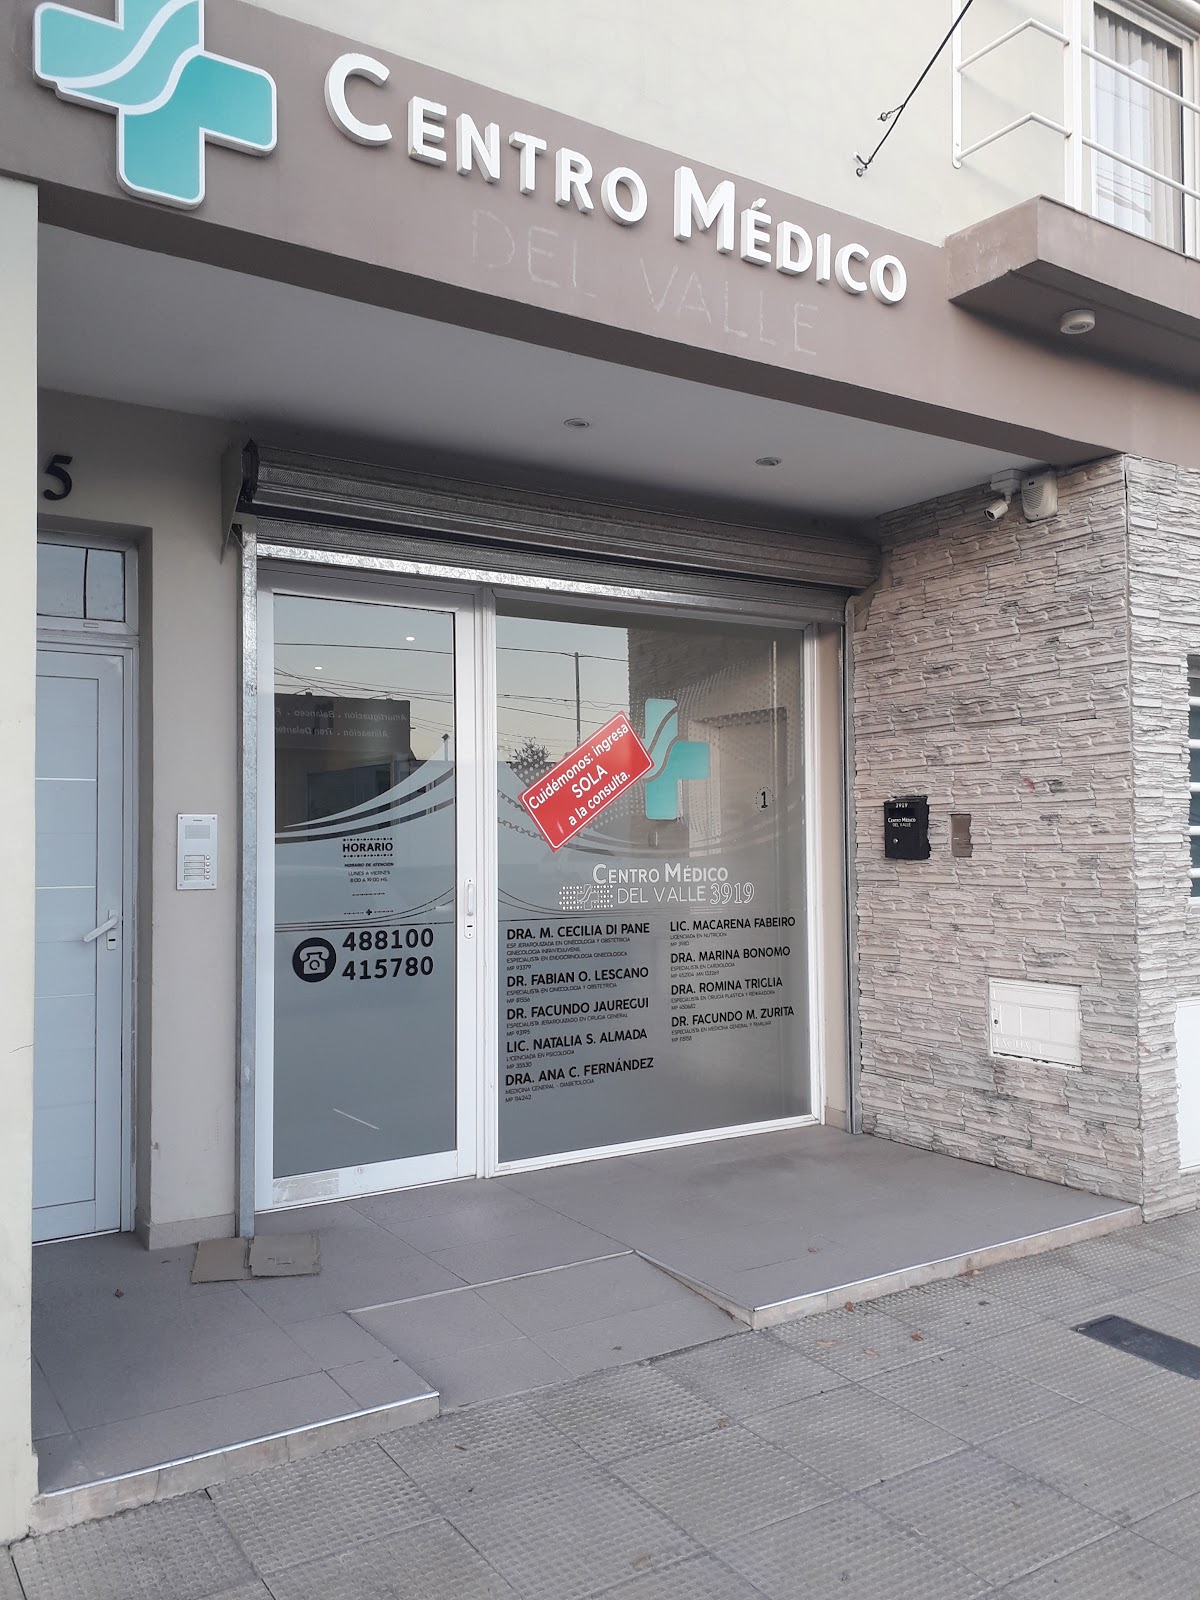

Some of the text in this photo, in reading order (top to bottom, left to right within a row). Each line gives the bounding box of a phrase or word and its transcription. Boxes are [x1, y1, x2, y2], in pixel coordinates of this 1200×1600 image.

[324, 52, 908, 305] CENTRO MÉDICO
[471, 208, 818, 357] DEL VALLE
[43, 455, 73, 500] 5
[528, 723, 630, 809] Cuidémonos: ingresa
[571, 764, 608, 799] SOLA
[568, 769, 631, 826] a la consulta.
[342, 842, 394, 853] HORARIO
[593, 862, 729, 884] CENTRO MÉDICO
[617, 882, 755, 905] DEL VALLE 3919
[506, 922, 651, 940] DRA. M. CECILIA DI PANE
[670, 916, 796, 932] LIC. MACARENA FABEIRO
[342, 927, 434, 951] 488100
[671, 946, 791, 964] DRA. MARINA BONOMO
[342, 955, 434, 981] 415780
[506, 966, 649, 988] DR. FABIAN O. LESCANO
[671, 976, 784, 996] DRA. ROMINA TRIGLIA
[506, 997, 649, 1021] DR. FACUNDO JAUREGUI
[671, 1005, 796, 1028] DR. FACUNDO M. ZURITA
[506, 1028, 648, 1054] LIC. NATALIA S. ALMADA
[505, 1057, 655, 1087] DRA. ANA C. FERNÁNDEZ
